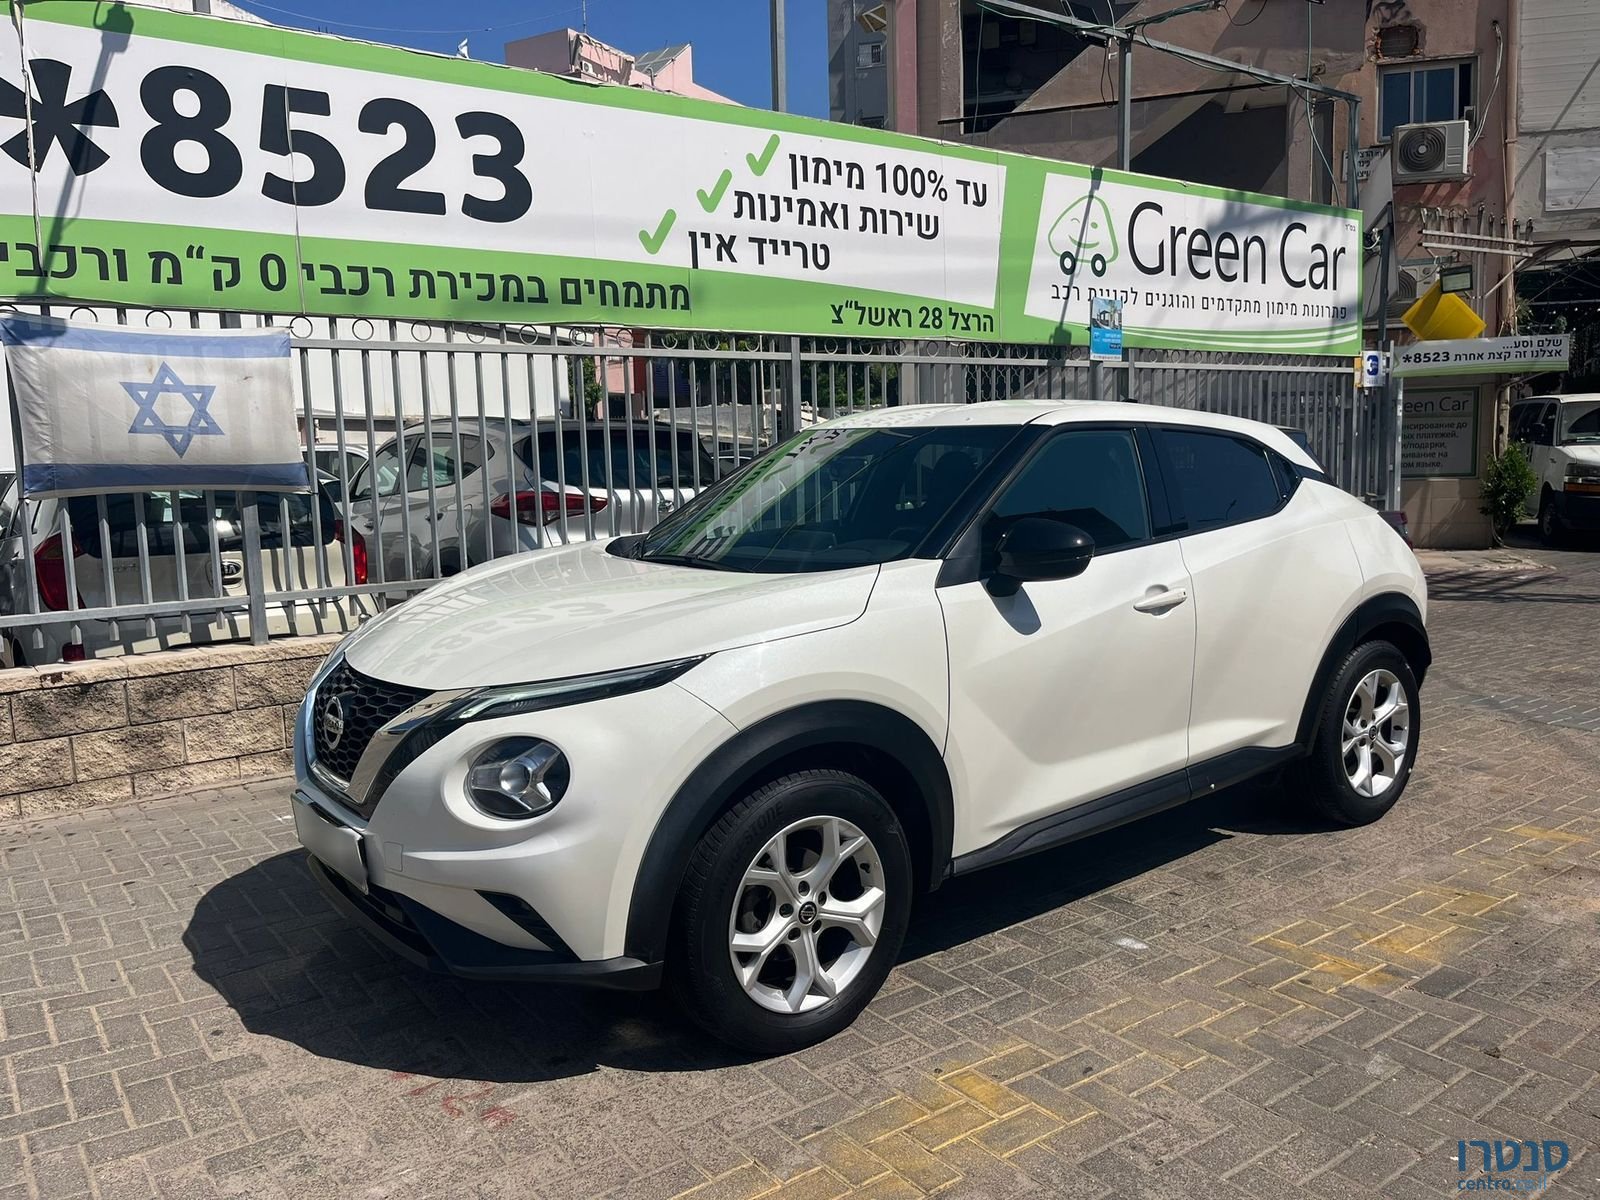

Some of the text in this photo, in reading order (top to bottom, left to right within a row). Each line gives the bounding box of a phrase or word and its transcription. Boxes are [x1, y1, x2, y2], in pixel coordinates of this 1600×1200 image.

[788, 152, 988, 208] עד 100% מימון
[733, 189, 940, 240] שירות ואמינות
[688, 230, 831, 271] טרייד אין
[1127, 201, 1347, 292] Green Car
[147, 243, 242, 292] ק"מ
[258, 253, 288, 292] 0
[301, 262, 396, 298] רכבי
[408, 268, 549, 305] במכירת
[559, 277, 691, 312] מתמחים
[1050, 283, 1080, 301] רכב
[1144, 291, 1196, 310] והוגנים
[830, 299, 995, 334] הרצל 28 ראשל"צ
[1201, 295, 1261, 317] מתקדמים
[1266, 300, 1298, 319] מימון
[1302, 303, 1347, 320] פתרונות
[1530, 348, 1563, 360] אצלנו
[1536, 338, 1563, 349] שלם
[1453, 352, 1485, 362] אחרת
[1487, 351, 1512, 362] קצת
[1514, 350, 1527, 360] זה
[1402, 396, 1470, 413] een Car
